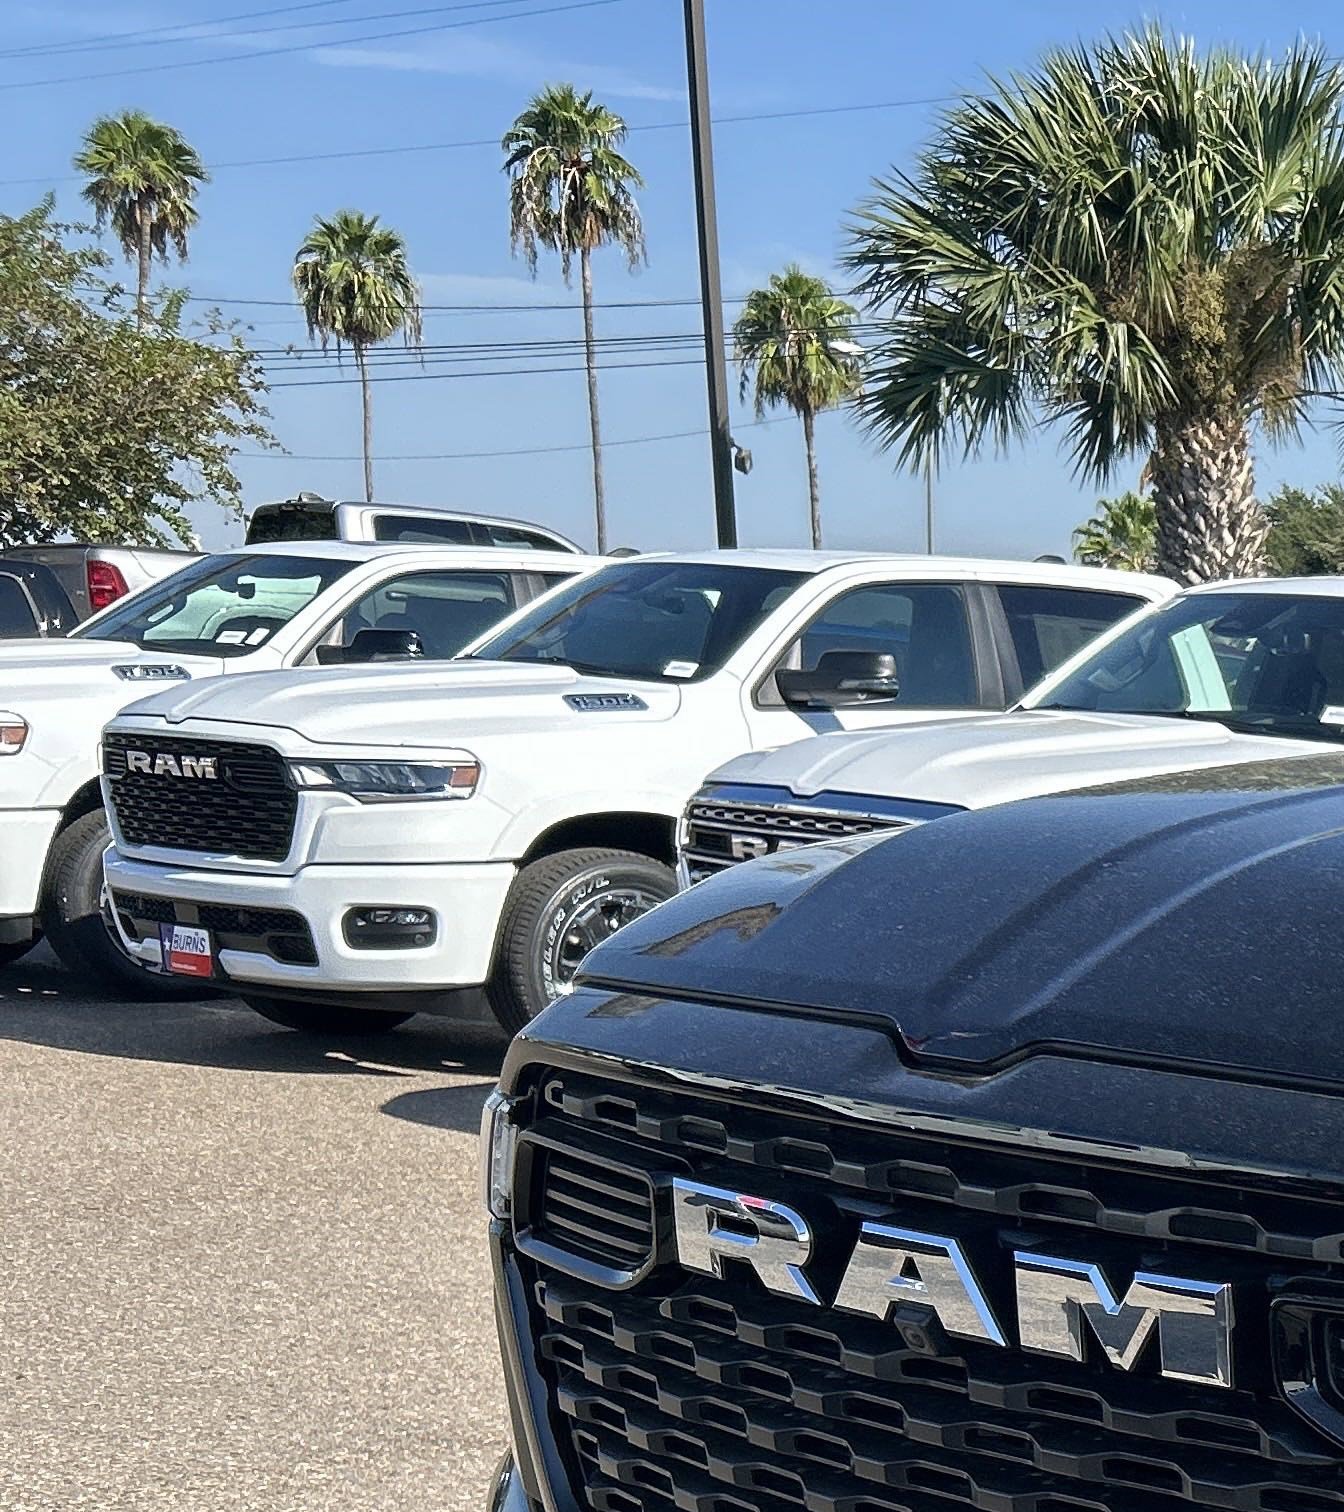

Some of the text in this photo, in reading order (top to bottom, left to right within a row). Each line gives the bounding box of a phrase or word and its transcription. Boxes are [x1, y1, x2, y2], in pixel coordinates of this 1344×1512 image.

[126, 750, 218, 779] RAM
[172, 933, 206, 953] BURNS
[672, 1177, 1236, 1389] RAM
